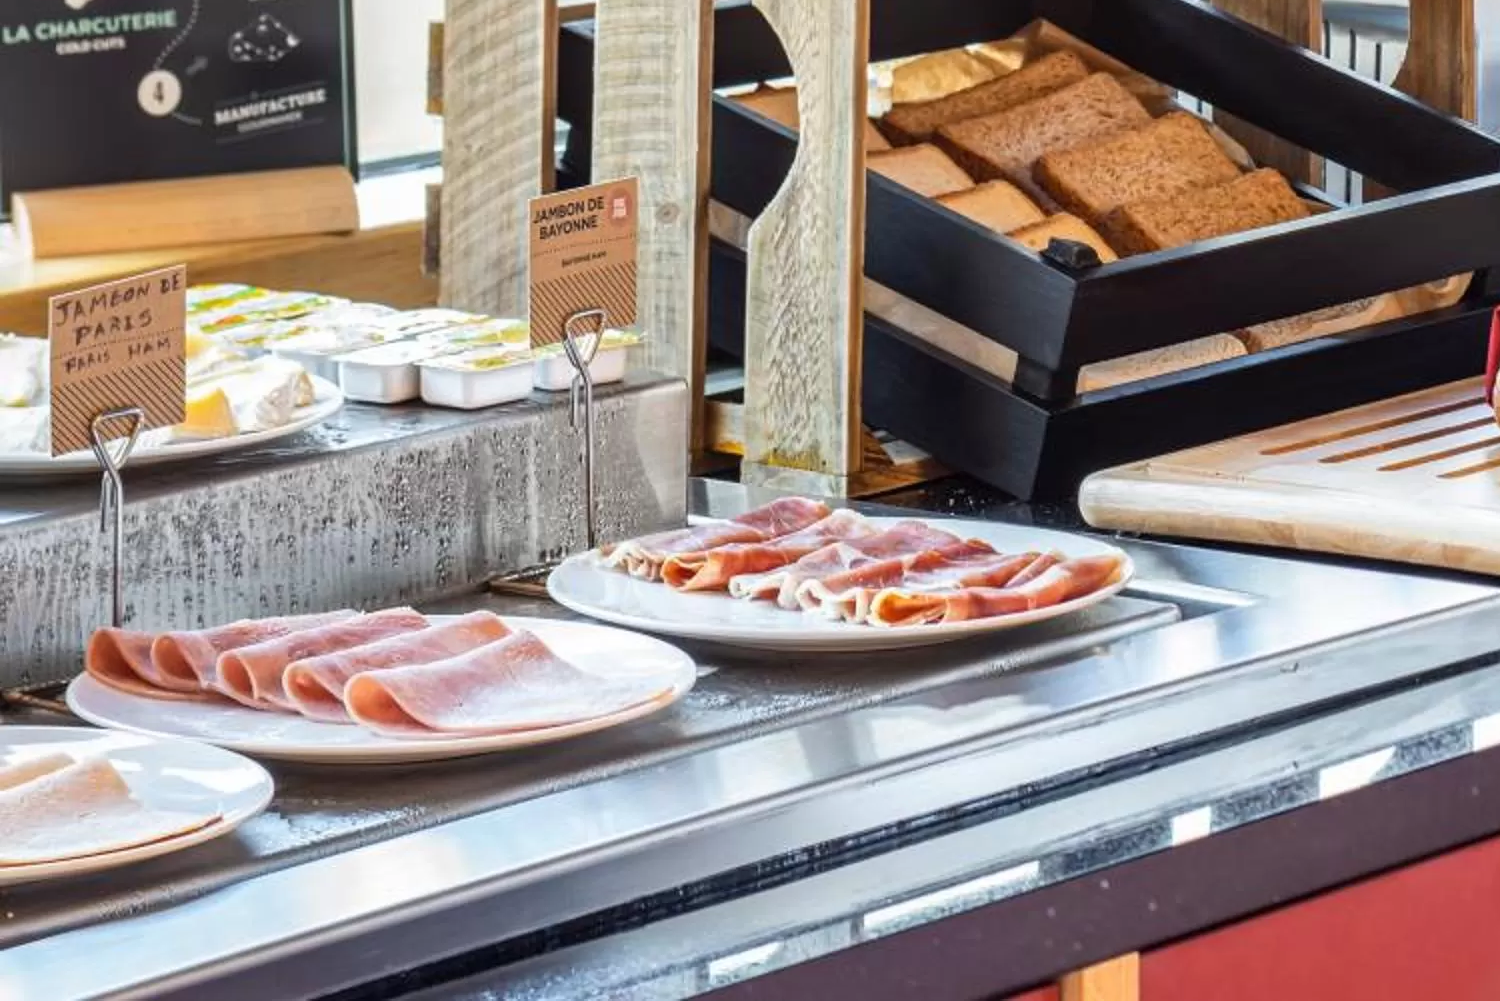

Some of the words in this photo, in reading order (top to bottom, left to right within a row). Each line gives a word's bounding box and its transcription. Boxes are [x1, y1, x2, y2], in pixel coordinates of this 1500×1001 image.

[2, 25, 30, 44] LA
[34, 9, 177, 40] CHARCUTERIE
[213, 87, 327, 126] MANUFACTURE
[533, 201, 585, 224] JAMBON
[587, 196, 605, 212] DE
[539, 215, 599, 240] BAYONNE
[159, 273, 182, 295] DE
[73, 308, 153, 346] PARIS
[64, 350, 111, 375] PARIS
[127, 336, 172, 360] HAM
